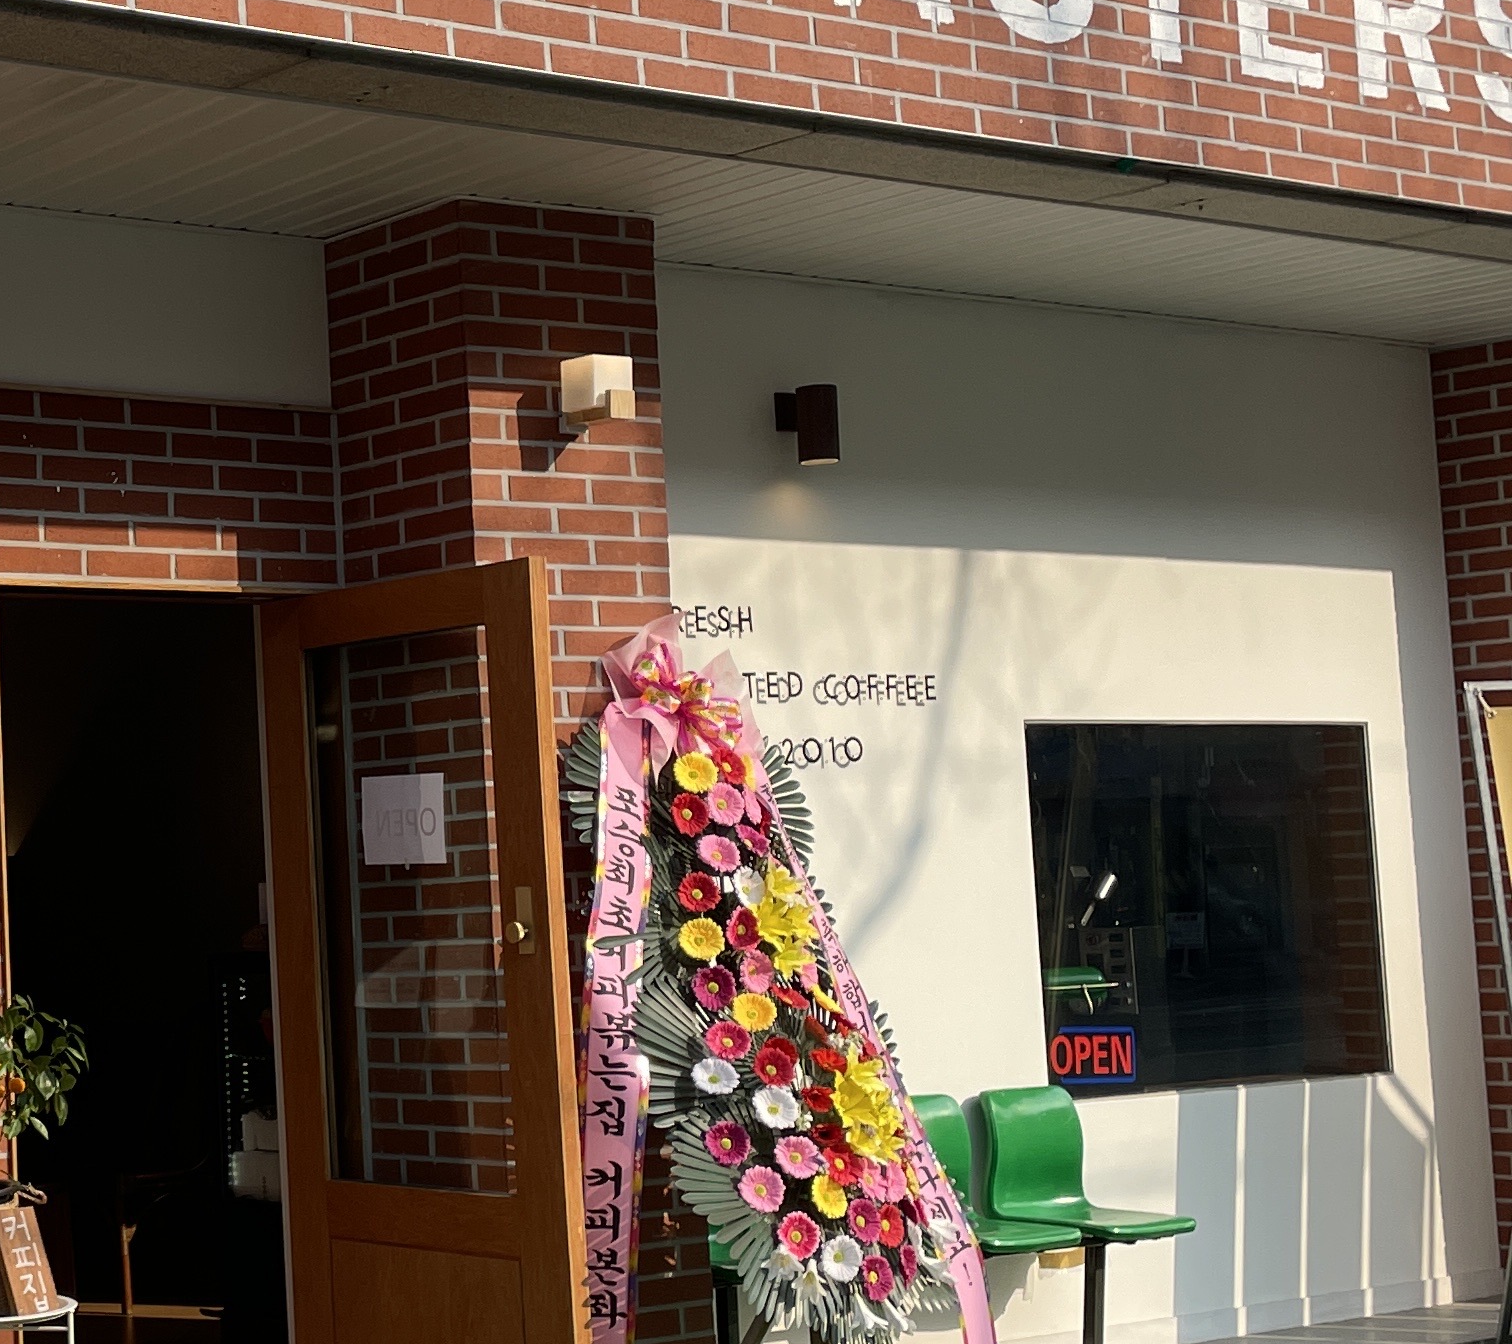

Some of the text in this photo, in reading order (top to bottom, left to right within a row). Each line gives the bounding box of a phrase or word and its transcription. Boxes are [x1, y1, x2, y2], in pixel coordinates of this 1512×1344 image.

[823, 673, 937, 701] COFFEE
[1050, 1033, 1134, 1078] OPEN
[1, 1210, 50, 1313] 커피집
